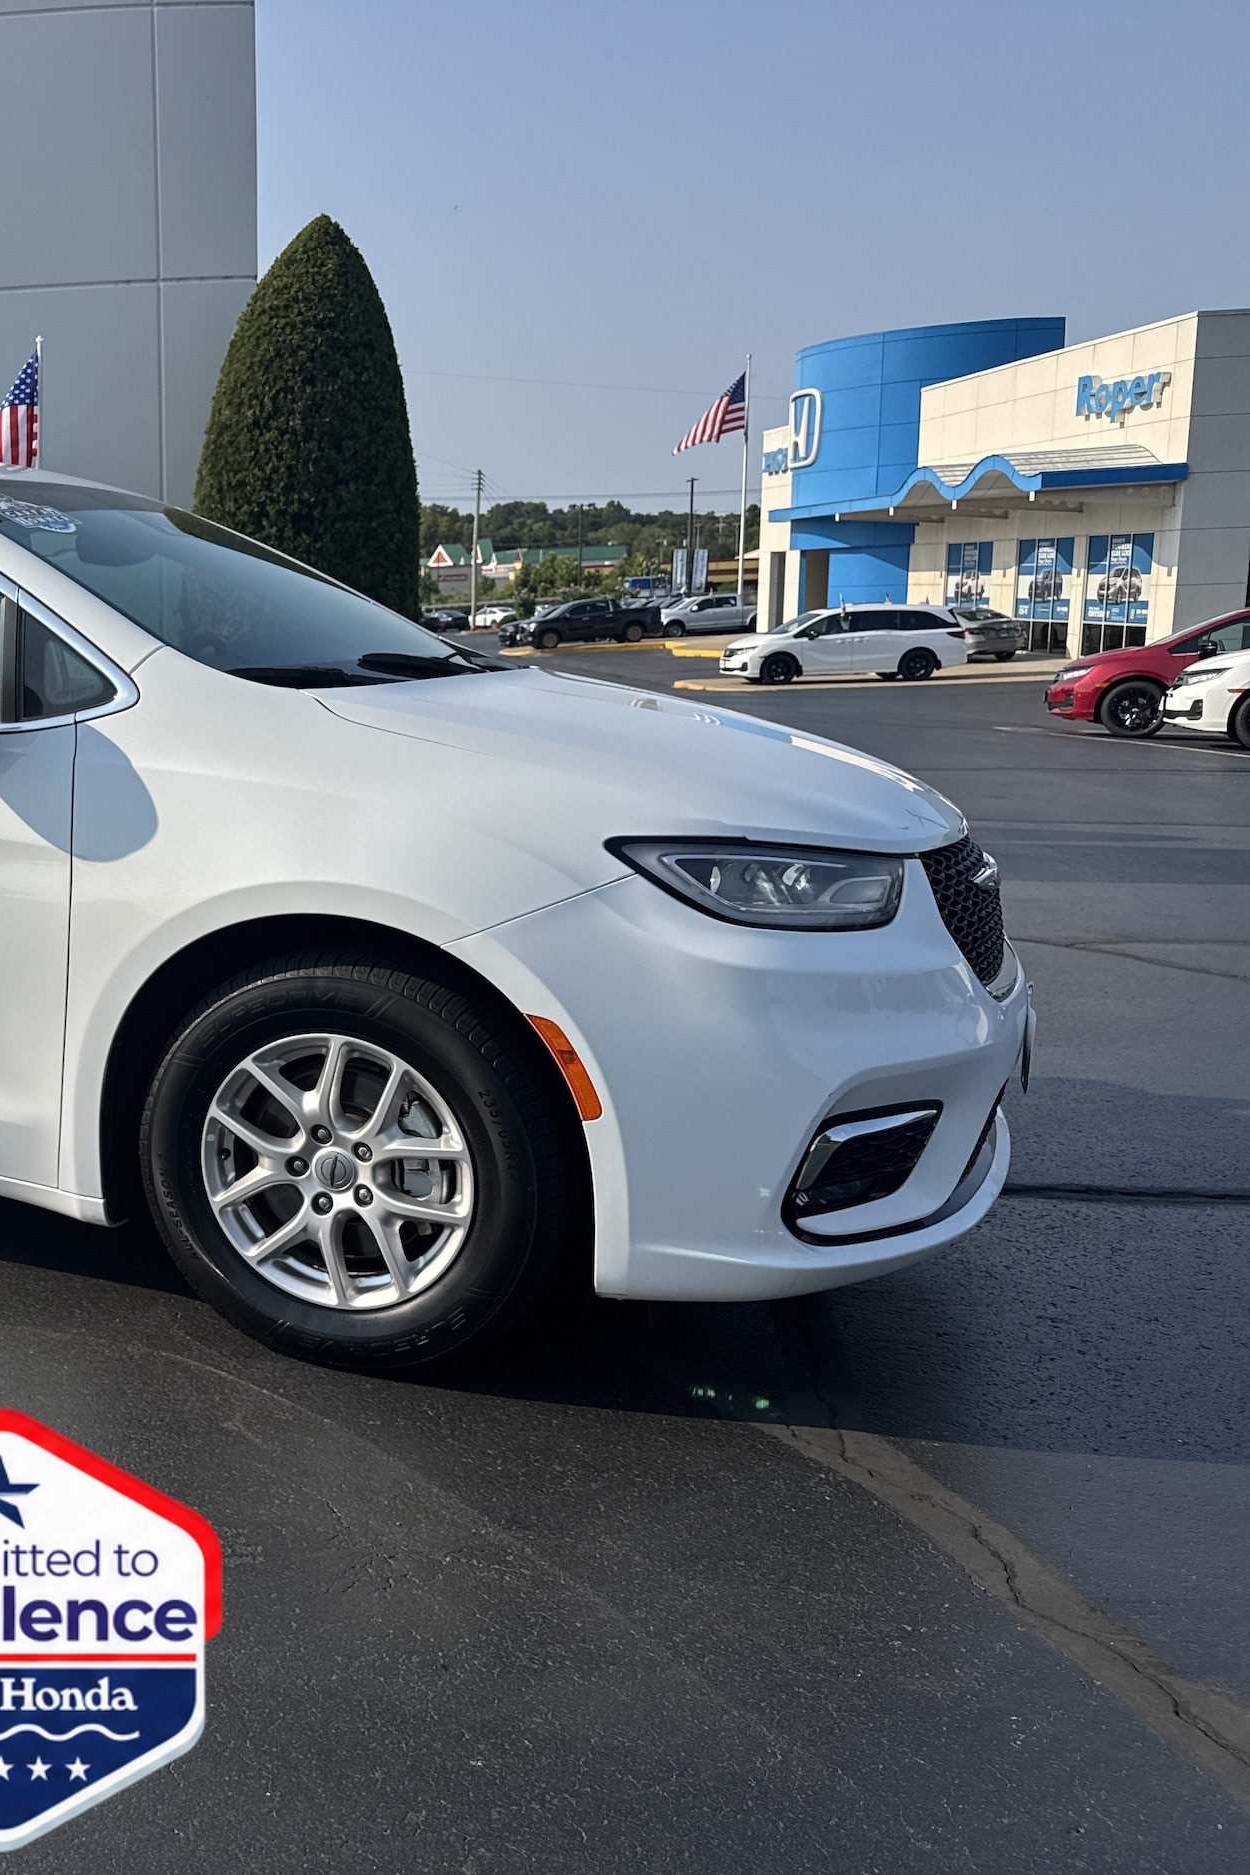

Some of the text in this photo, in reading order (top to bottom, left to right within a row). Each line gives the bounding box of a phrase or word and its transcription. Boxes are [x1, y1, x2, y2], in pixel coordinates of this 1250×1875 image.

[1076, 371, 1169, 424] Roper
[199, 989, 358, 1048] SUREDRIVE
[159, 1167, 200, 1260] ALL-SEASON
